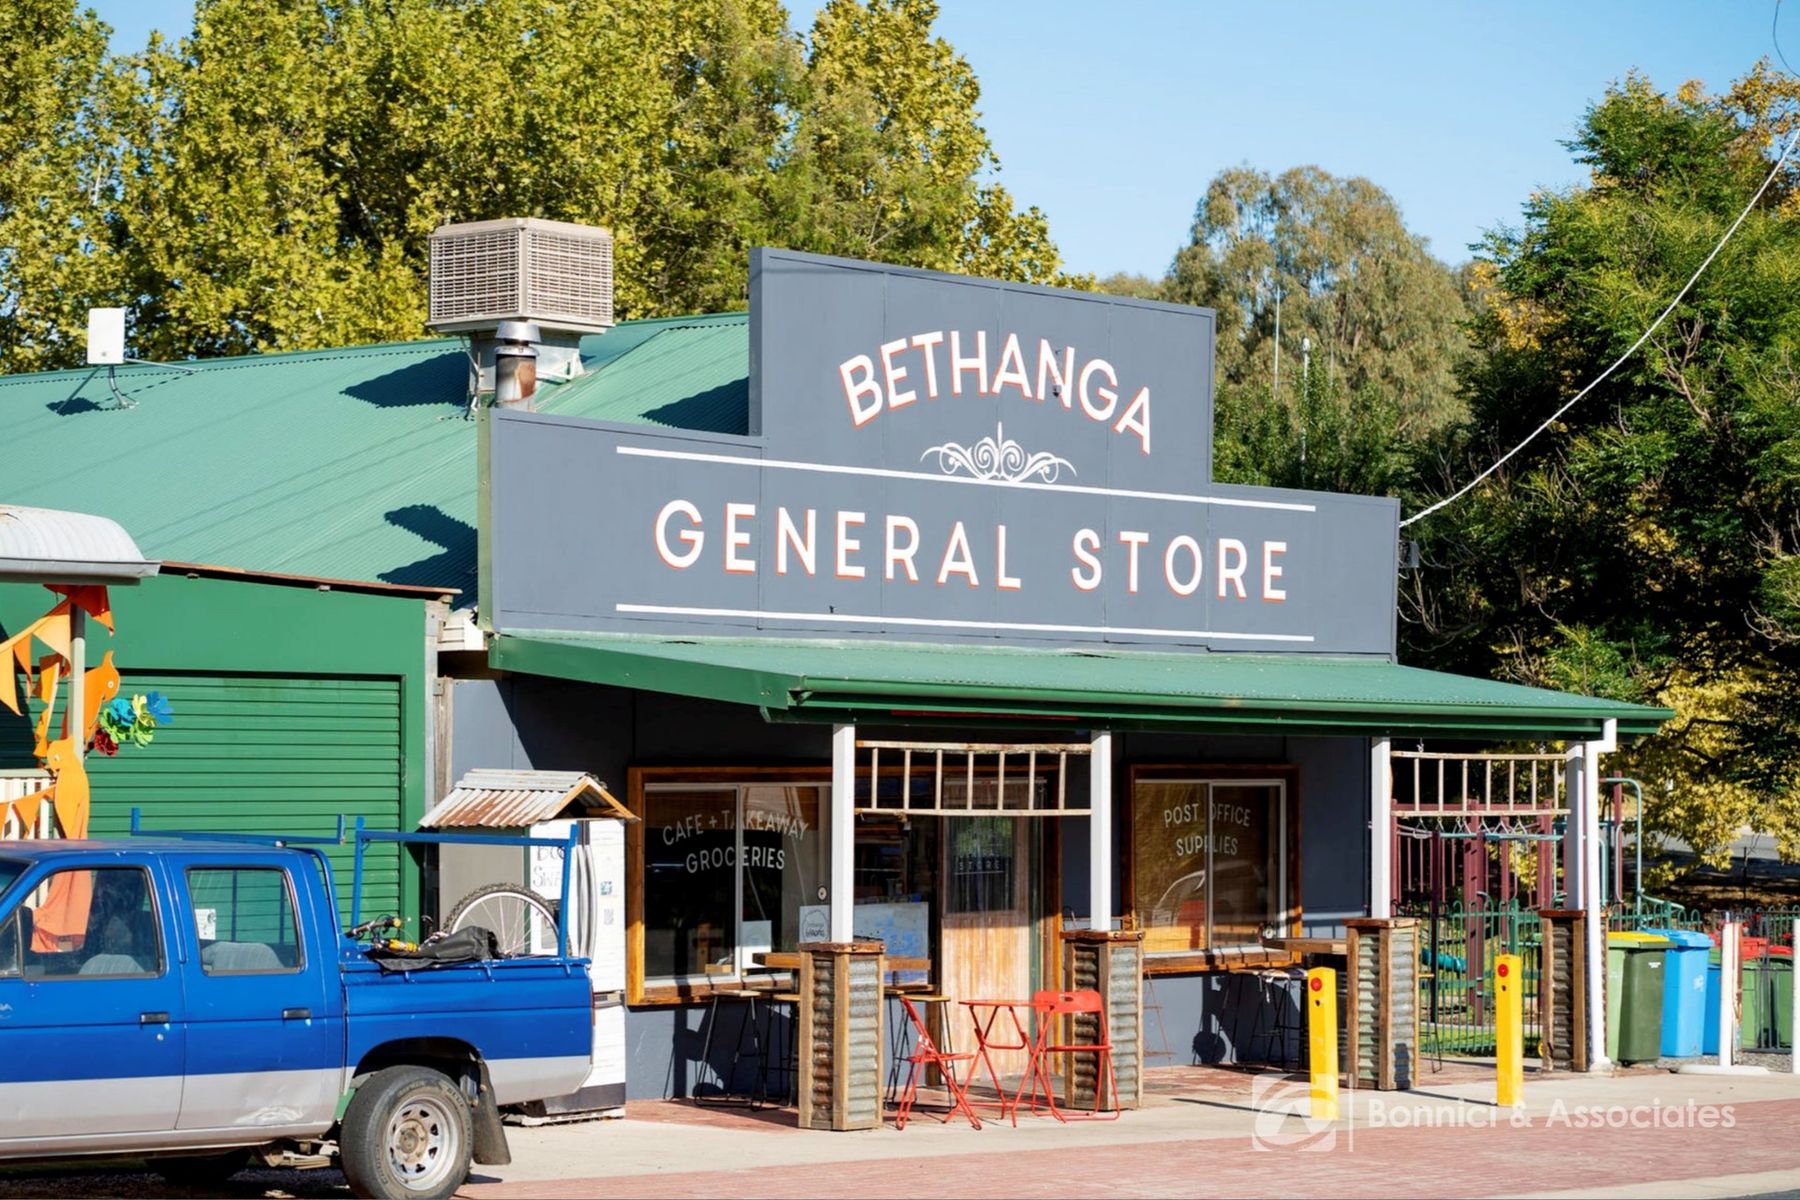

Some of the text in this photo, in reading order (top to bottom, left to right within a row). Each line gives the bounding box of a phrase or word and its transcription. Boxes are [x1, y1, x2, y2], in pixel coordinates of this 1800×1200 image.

[839, 329, 1151, 455] BETHANGA
[654, 499, 1288, 601] GENERAL STORE
[662, 814, 704, 845] CAFE
[1164, 803, 1251, 828] POST OFFICE
[686, 846, 785, 873] GROCERIES
